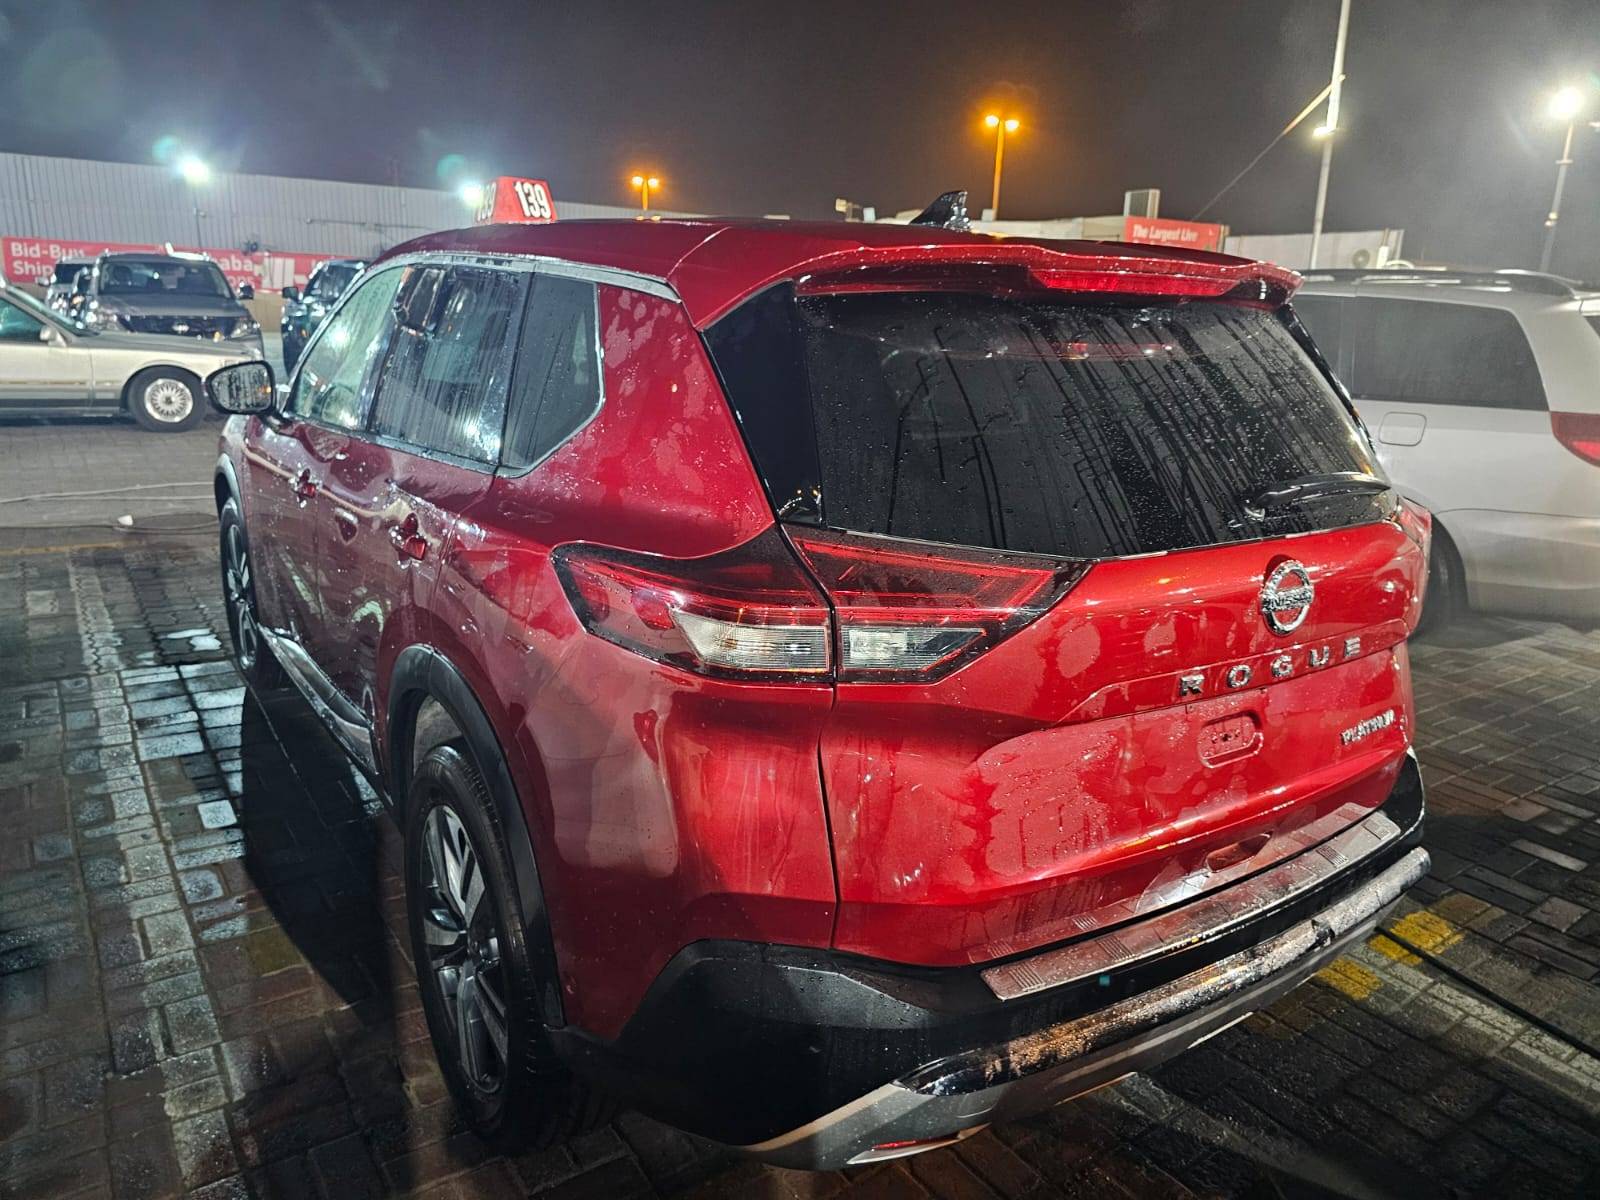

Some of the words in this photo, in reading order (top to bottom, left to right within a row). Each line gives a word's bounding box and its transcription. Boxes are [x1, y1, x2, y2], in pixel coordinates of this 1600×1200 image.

[514, 181, 552, 219] 139
[1133, 223, 1149, 238] The
[1149, 225, 1181, 242] Largest
[1181, 227, 1199, 242] Live
[1179, 637, 1361, 697] ROGUE
[1340, 708, 1396, 746] PLATINUM
